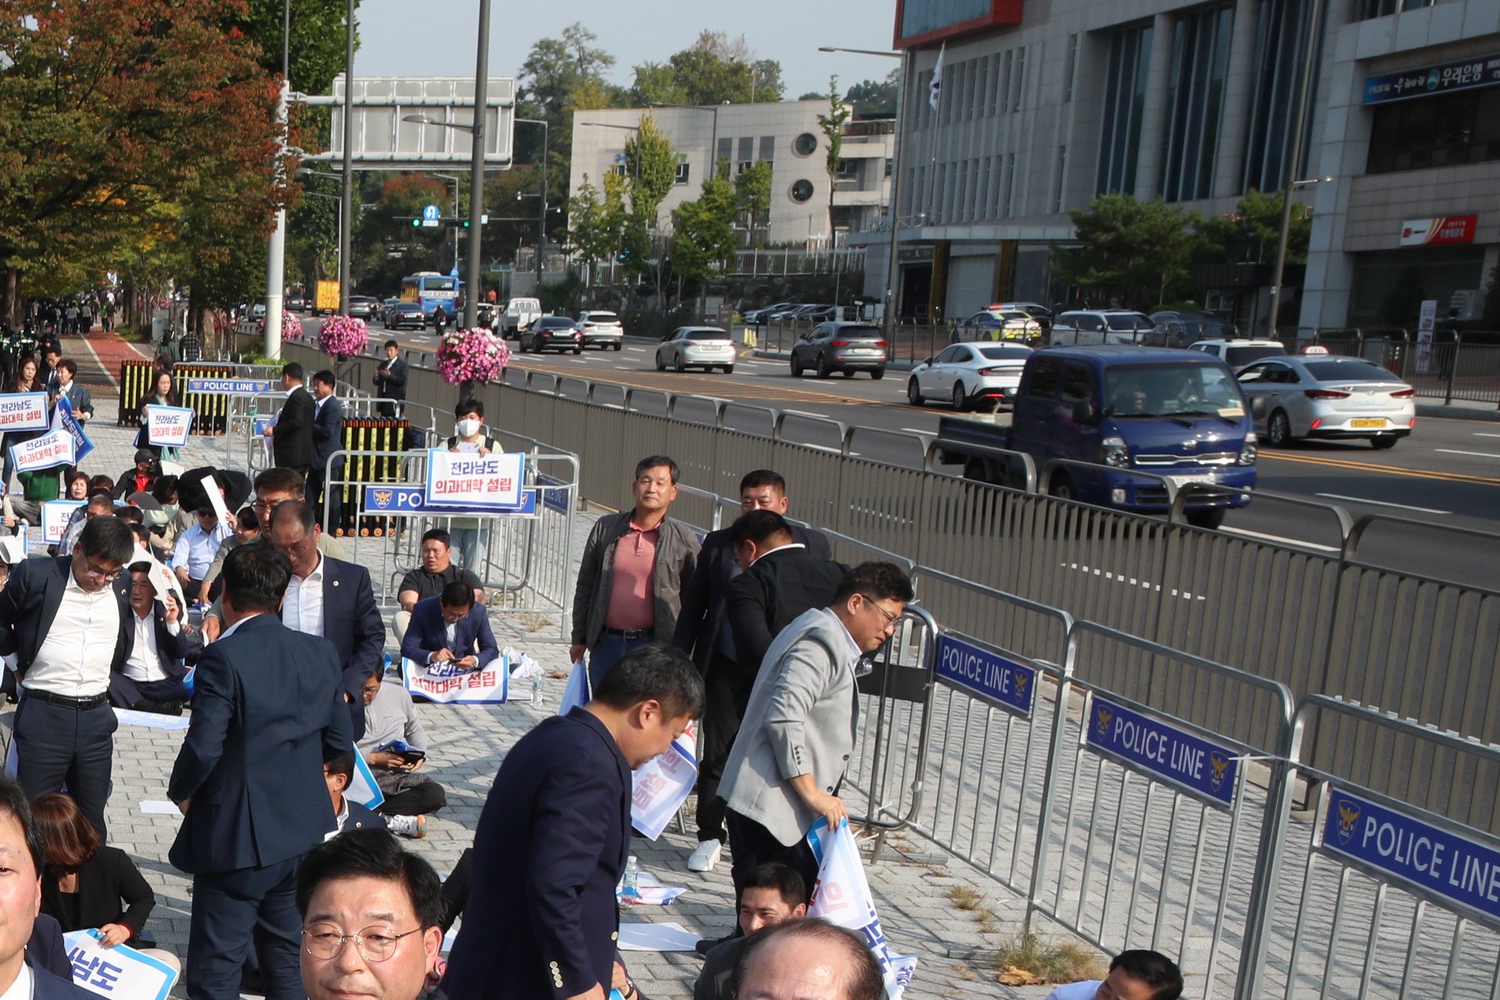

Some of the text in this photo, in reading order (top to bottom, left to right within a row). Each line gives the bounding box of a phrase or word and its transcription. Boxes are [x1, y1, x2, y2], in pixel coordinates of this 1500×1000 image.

[1441, 63, 1483, 87] 우리은행
[203, 382, 253, 391] POLICE LINE
[1, 400, 32, 413] 전라남도
[26, 410, 42, 421] 설립
[155, 414, 180, 425] 전라남도
[171, 426, 184, 437] 설립
[25, 433, 60, 452] 전라남도
[18, 446, 52, 465] 의과대학
[450, 460, 499, 476] 전라남도
[434, 477, 512, 495] 의과대학 설립
[941, 644, 1011, 695] POLICE LINE
[411, 671, 496, 695] 의과대학 설립
[1113, 716, 1205, 780] POLICE LINE
[1362, 815, 1500, 903] POLICE LINE
